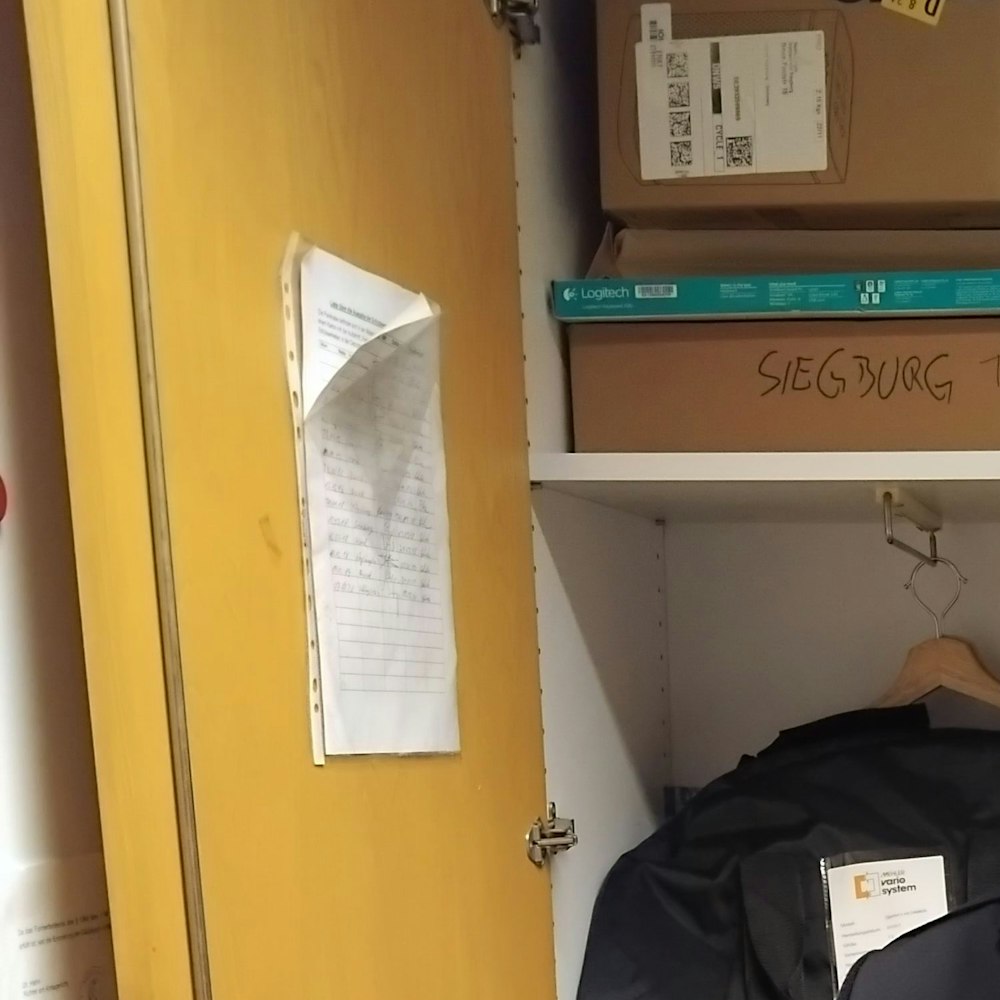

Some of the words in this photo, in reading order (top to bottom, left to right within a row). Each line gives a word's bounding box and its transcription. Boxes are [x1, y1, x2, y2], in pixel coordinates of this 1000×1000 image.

[714, 124, 724, 150] CYCLE
[581, 287, 629, 301] Logitech
[757, 348, 953, 404] SIEGBURG
[881, 877, 906, 886] vario
[882, 884, 917, 896] system
